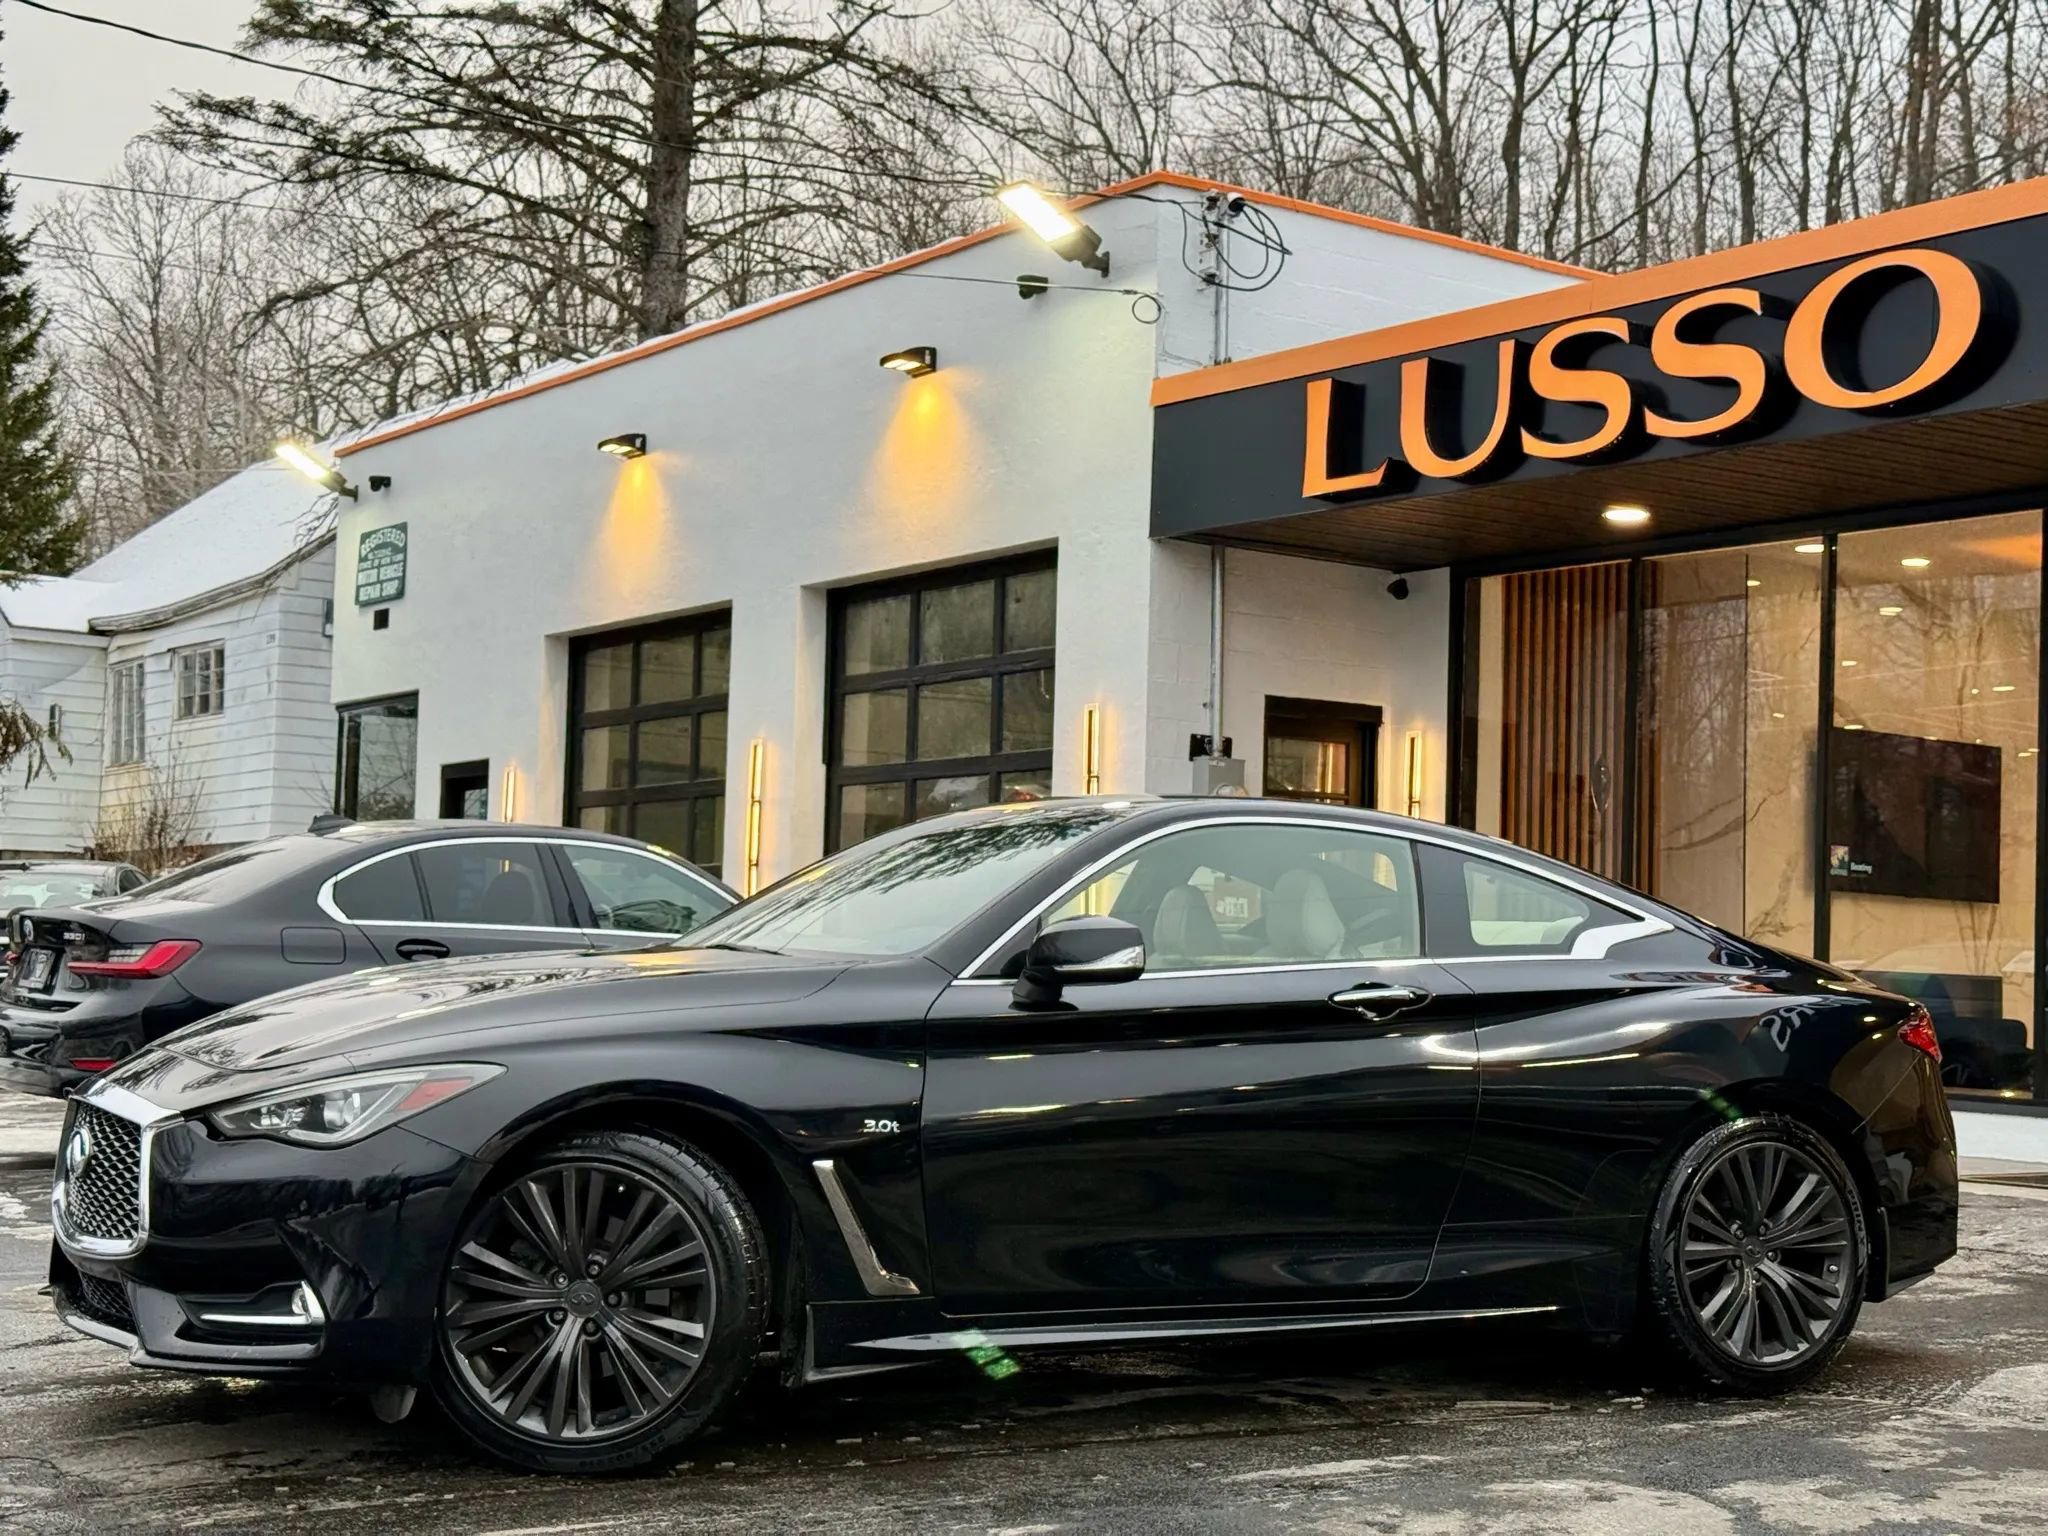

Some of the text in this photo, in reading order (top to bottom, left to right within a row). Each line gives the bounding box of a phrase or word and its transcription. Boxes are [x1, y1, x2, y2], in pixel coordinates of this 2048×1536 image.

[1302, 248, 1981, 497] LUSSO
[361, 528, 406, 558] REGISTERED
[863, 1119, 900, 1133] 3.0t
